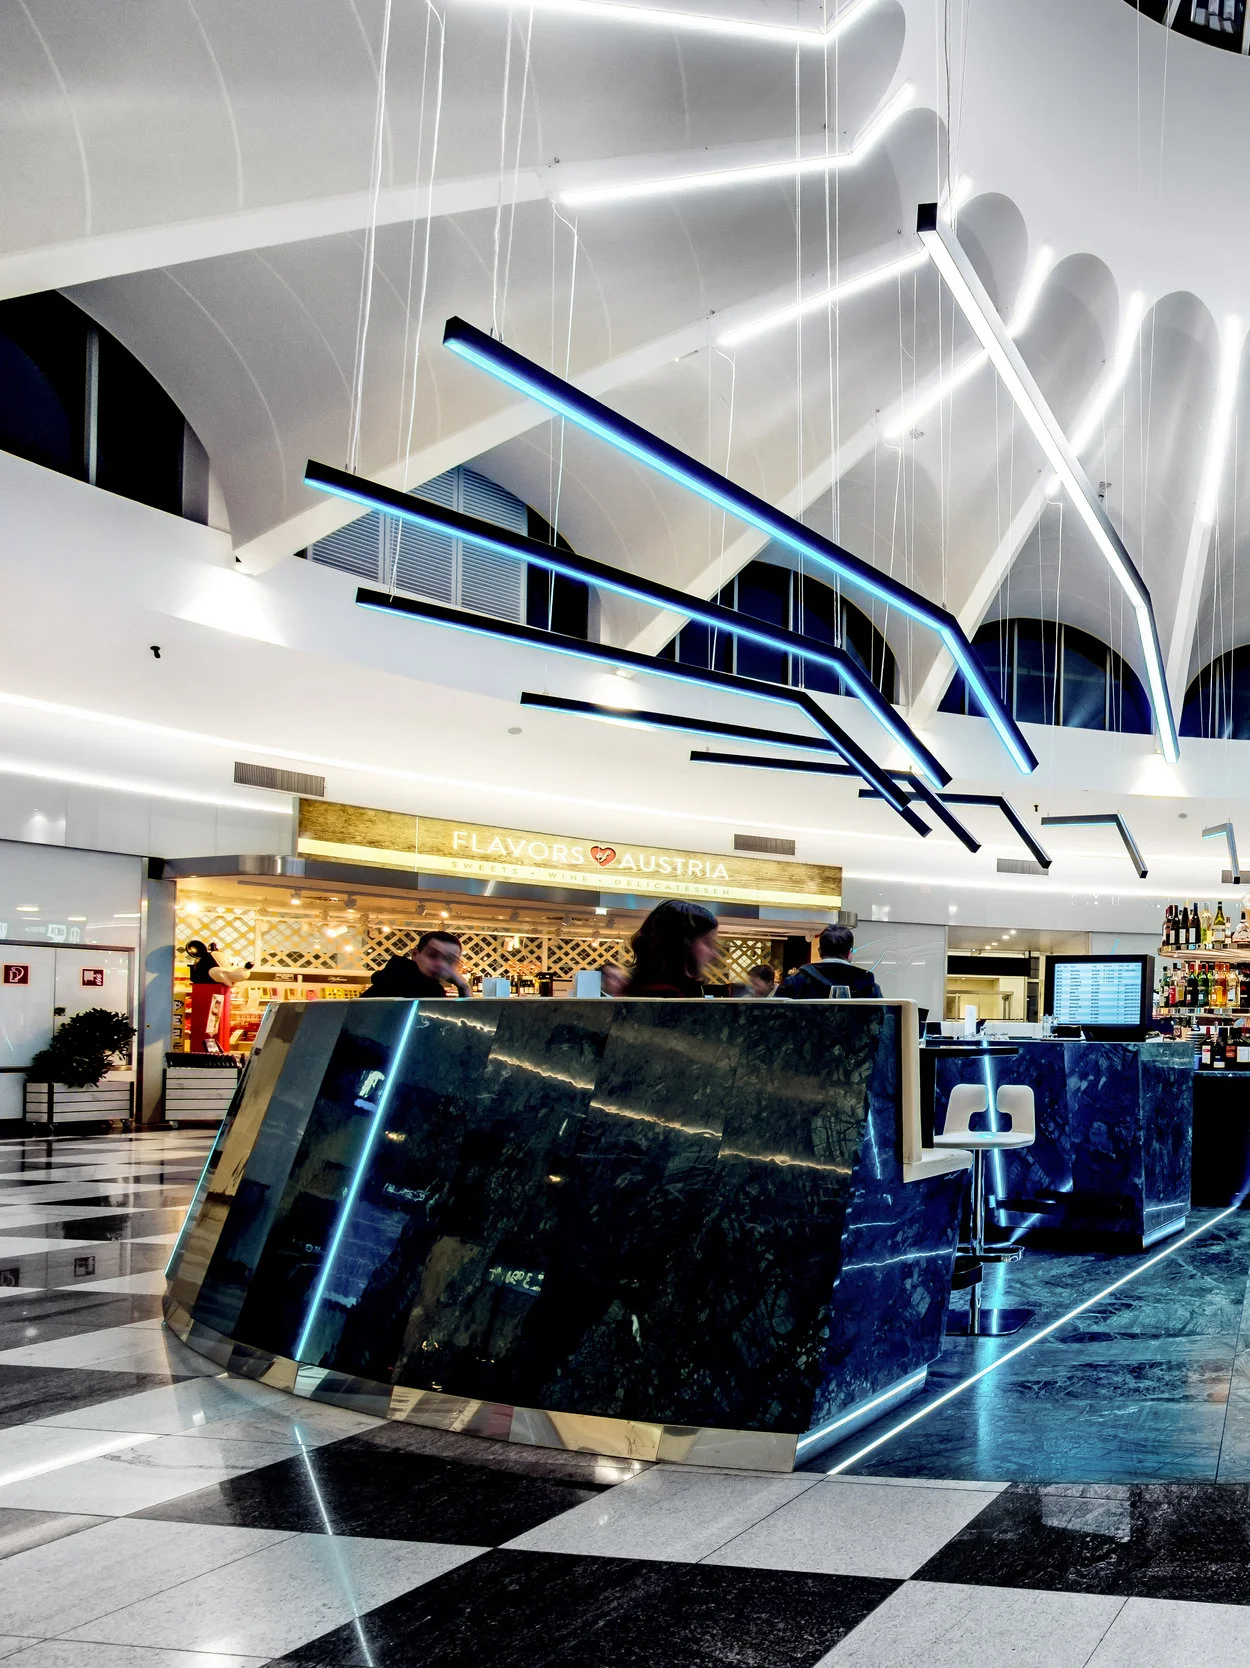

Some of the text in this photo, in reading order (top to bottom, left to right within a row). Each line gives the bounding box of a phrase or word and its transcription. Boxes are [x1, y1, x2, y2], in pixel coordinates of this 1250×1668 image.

[452, 830, 729, 879] FLAVORS of AUSTRIA
[451, 861, 730, 895] SWEETS WINE DELICATESSEN
